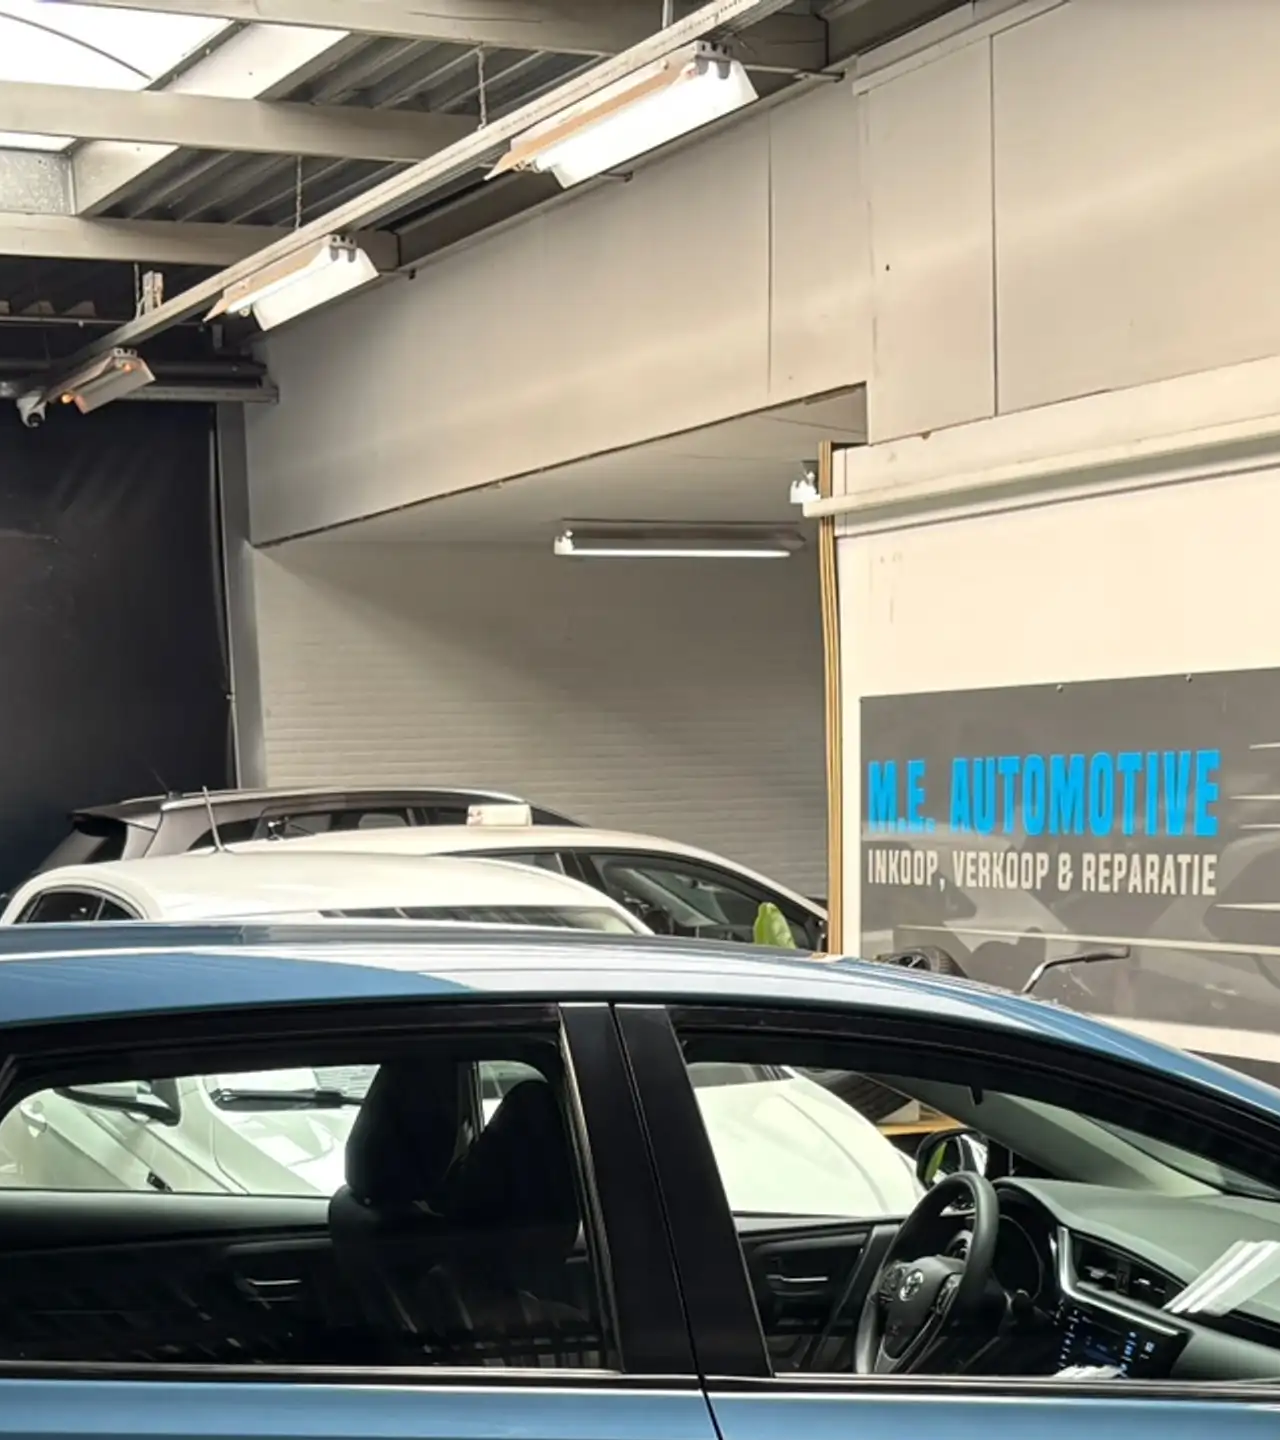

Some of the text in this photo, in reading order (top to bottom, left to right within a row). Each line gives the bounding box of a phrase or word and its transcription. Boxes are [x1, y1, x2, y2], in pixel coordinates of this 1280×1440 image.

[868, 748, 1221, 837] M.E. AUTOMOTIVE
[868, 849, 1218, 896] INKOOP, VERKOOP & REPARATIE
